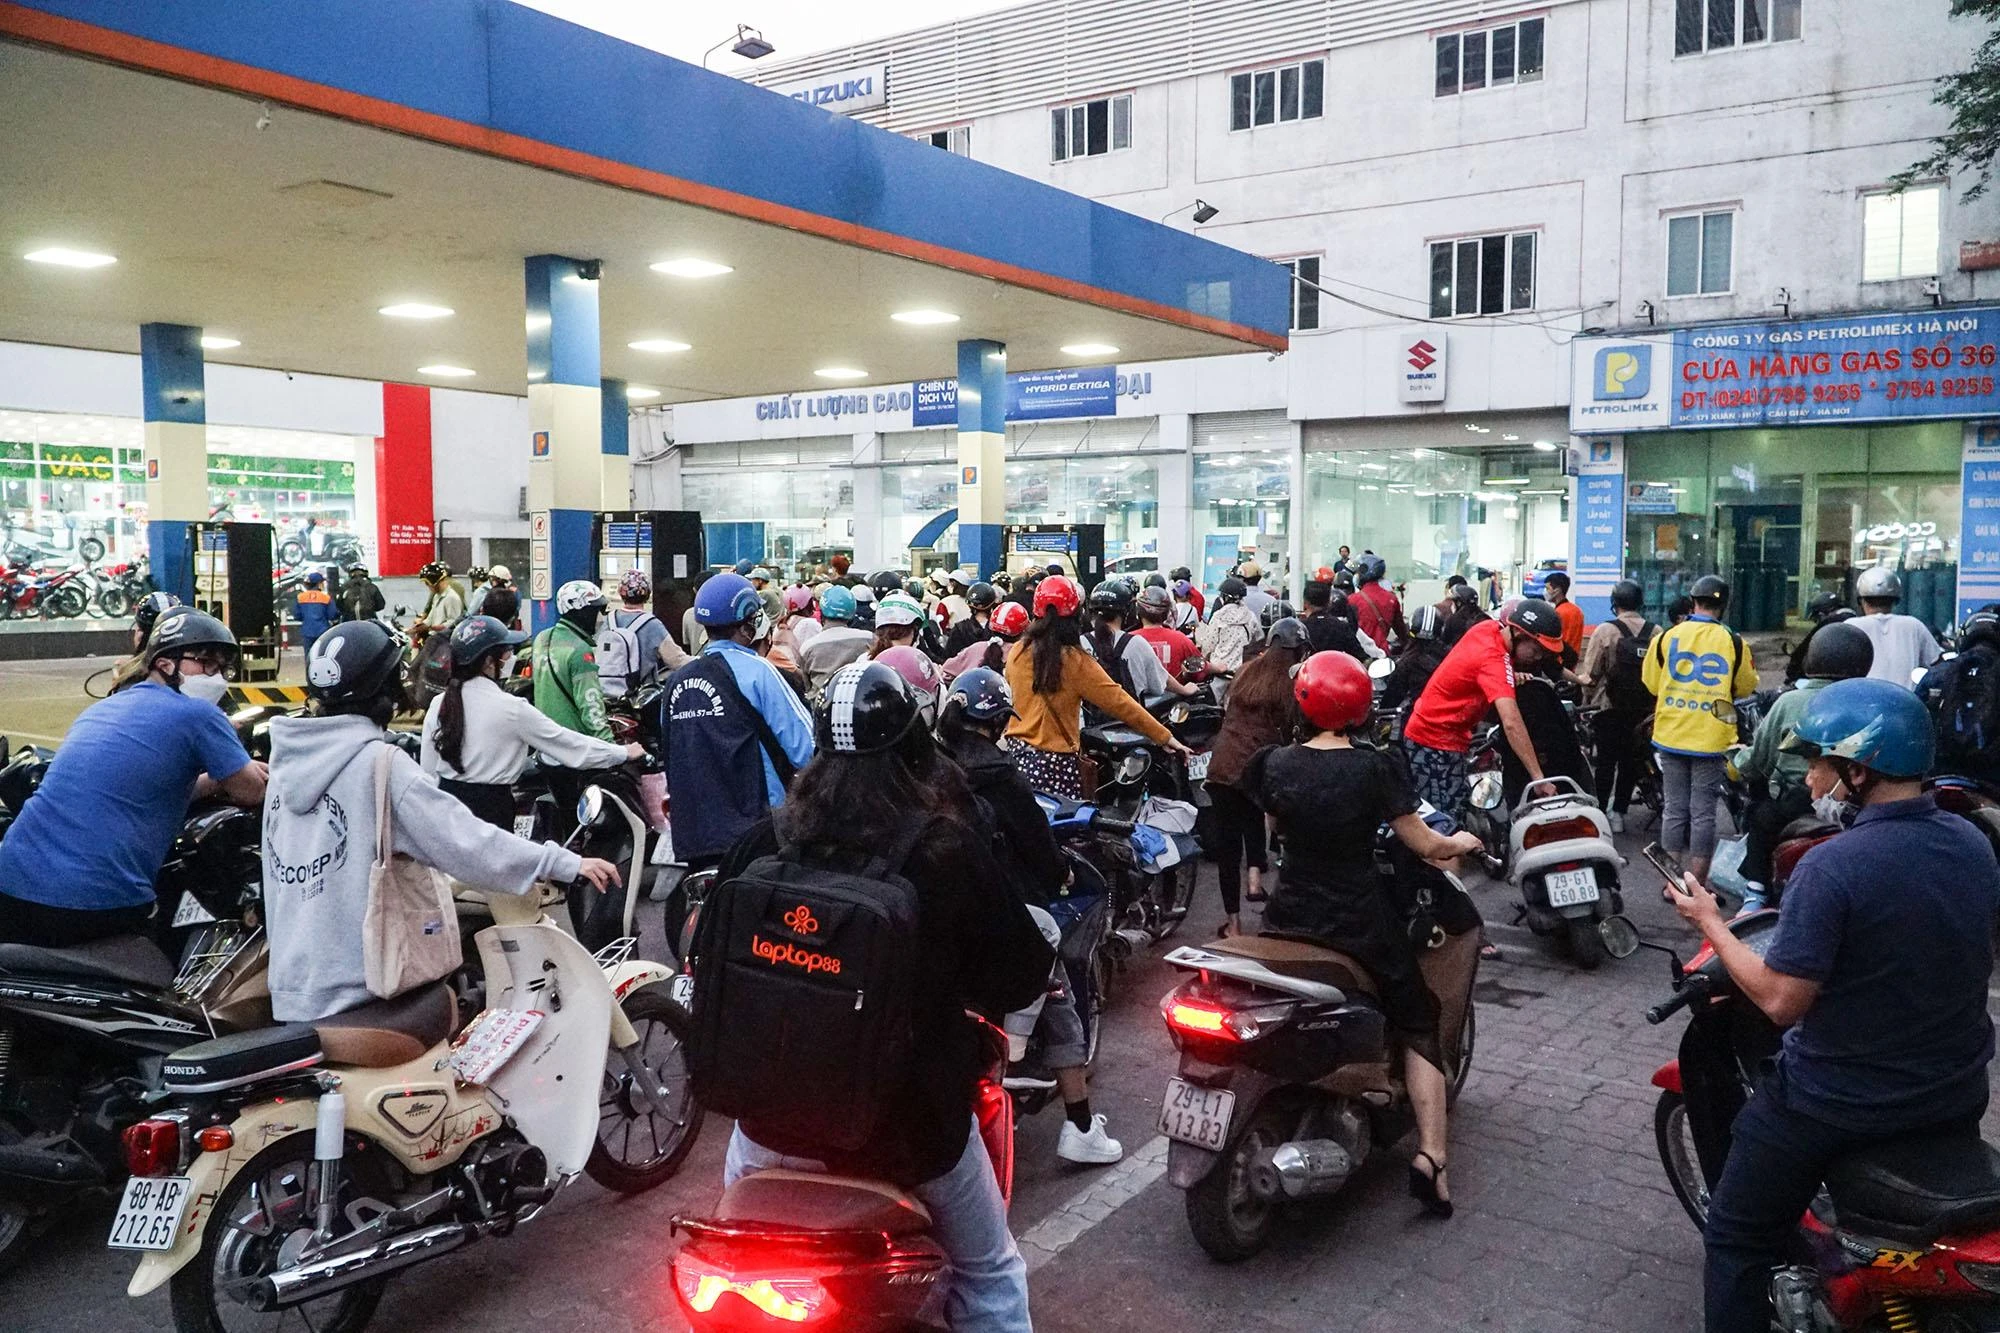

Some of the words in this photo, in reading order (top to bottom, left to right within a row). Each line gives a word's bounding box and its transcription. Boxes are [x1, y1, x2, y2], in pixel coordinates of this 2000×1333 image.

[1693, 334, 1739, 348] CÔNG
[1744, 334, 1765, 345] TY
[1769, 331, 1803, 343] GAS
[1807, 322, 1914, 341] PETROLIMEX
[1918, 318, 1942, 333] HÀ
[1946, 316, 1978, 334] NỘI
[1682, 352, 1740, 382] CỬA
[1749, 348, 1831, 378] HÀNG
[1840, 349, 1901, 374] GAS
[1911, 334, 1953, 370] SỐ
[1959, 343, 1997, 367] 36
[919, 394, 939, 405] DỊCH
[941, 392, 955, 403] VỤ
[1025, 383, 1067, 394] HYBRID
[1069, 381, 1110, 391] ERTIGA
[1812, 383, 1861, 404] 9255
[1885, 380, 1936, 400] 3754
[1940, 376, 1995, 397] 9255
[756, 392, 802, 420] CHẤT
[807, 395, 868, 420] LƯỢNG
[873, 391, 911, 413] CAO
[1581, 403, 1658, 414] PETROLIMEX
[46, 453, 110, 480] VAC
[1668, 637, 1729, 686] be
[1554, 871, 1588, 889] 29-G1
[1554, 885, 1595, 904] 460.88
[33, 992, 100, 1007] BLADE
[161, 1020, 191, 1032] 125
[1298, 1021, 1340, 1031] LEAD
[164, 1066, 206, 1076] HONDA
[1172, 1083, 1222, 1118] 29-L1
[1162, 1111, 1221, 1145] 413.83
[130, 1181, 179, 1211] 88-AB
[112, 1213, 174, 1245] 212.65
[1872, 1248, 1925, 1274] ZX
